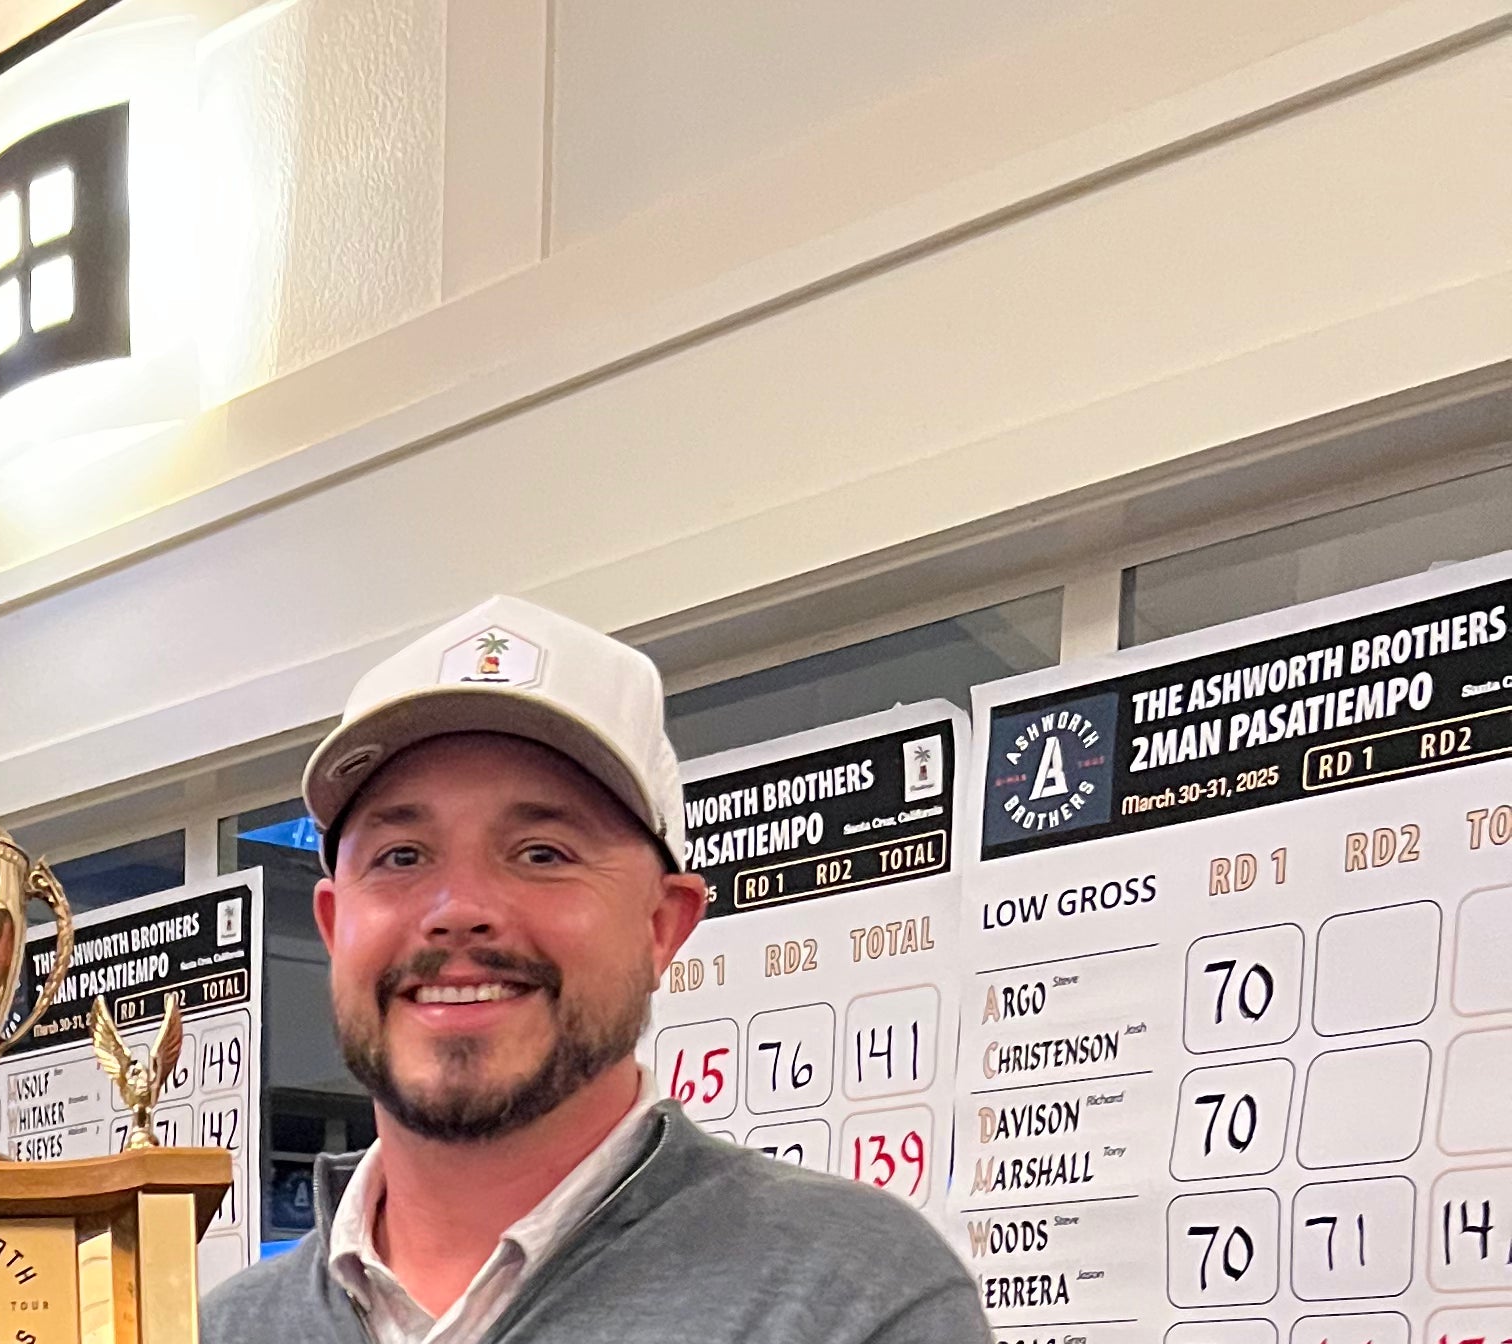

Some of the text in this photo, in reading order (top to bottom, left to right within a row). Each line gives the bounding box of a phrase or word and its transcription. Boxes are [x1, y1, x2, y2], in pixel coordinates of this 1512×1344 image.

[1131, 605, 1508, 725] THE ASHWORTH BROTHERS
[1006, 711, 1099, 765] ASHWORTH
[1129, 723, 1222, 774] 2MAN
[1228, 671, 1434, 752] PASATIEMPO
[1318, 726, 1474, 780] RD 1 RD2
[685, 759, 875, 830] WORTH BROTHERS
[1004, 781, 1094, 830] BROTHERS
[1121, 765, 1280, 817] March 30-31, 2025
[682, 811, 825, 871] PASATIEMPO
[1208, 853, 1257, 898] RD
[1270, 847, 1288, 885] 1
[1344, 823, 1422, 873] RD2
[745, 875, 770, 900] RD
[775, 872, 785, 894] 1
[816, 859, 853, 886] RD2
[879, 841, 936, 872] TOTAL
[982, 873, 1158, 931] LOW GROSS
[131, 912, 201, 952] BROTHERS
[670, 916, 935, 993] RD 1 RD2 TOTAL
[79, 951, 170, 999] PASATIEMPO
[120, 1003, 136, 1021] RD
[202, 976, 241, 1001] TOTAL
[1203, 960, 1275, 1025] 70
[981, 981, 1046, 1025] ARGO
[201, 1037, 241, 1087] 149
[670, 1021, 919, 1105] 65 76 141
[982, 1030, 1120, 1079] CHRISTENSON
[201, 1108, 240, 1150] 142
[978, 1098, 1081, 1144] DAVISON
[1195, 1093, 1258, 1157] 70
[854, 1131, 925, 1197] 139
[970, 1150, 1095, 1196] MARSHALL
[967, 1218, 1049, 1259] WOODS
[1188, 1226, 1255, 1292] 70
[1305, 1213, 1367, 1272] 71
[1443, 1200, 1512, 1266] 14
[10, 1301, 50, 1311] TOUR
[979, 1273, 1070, 1310] ERRERA
